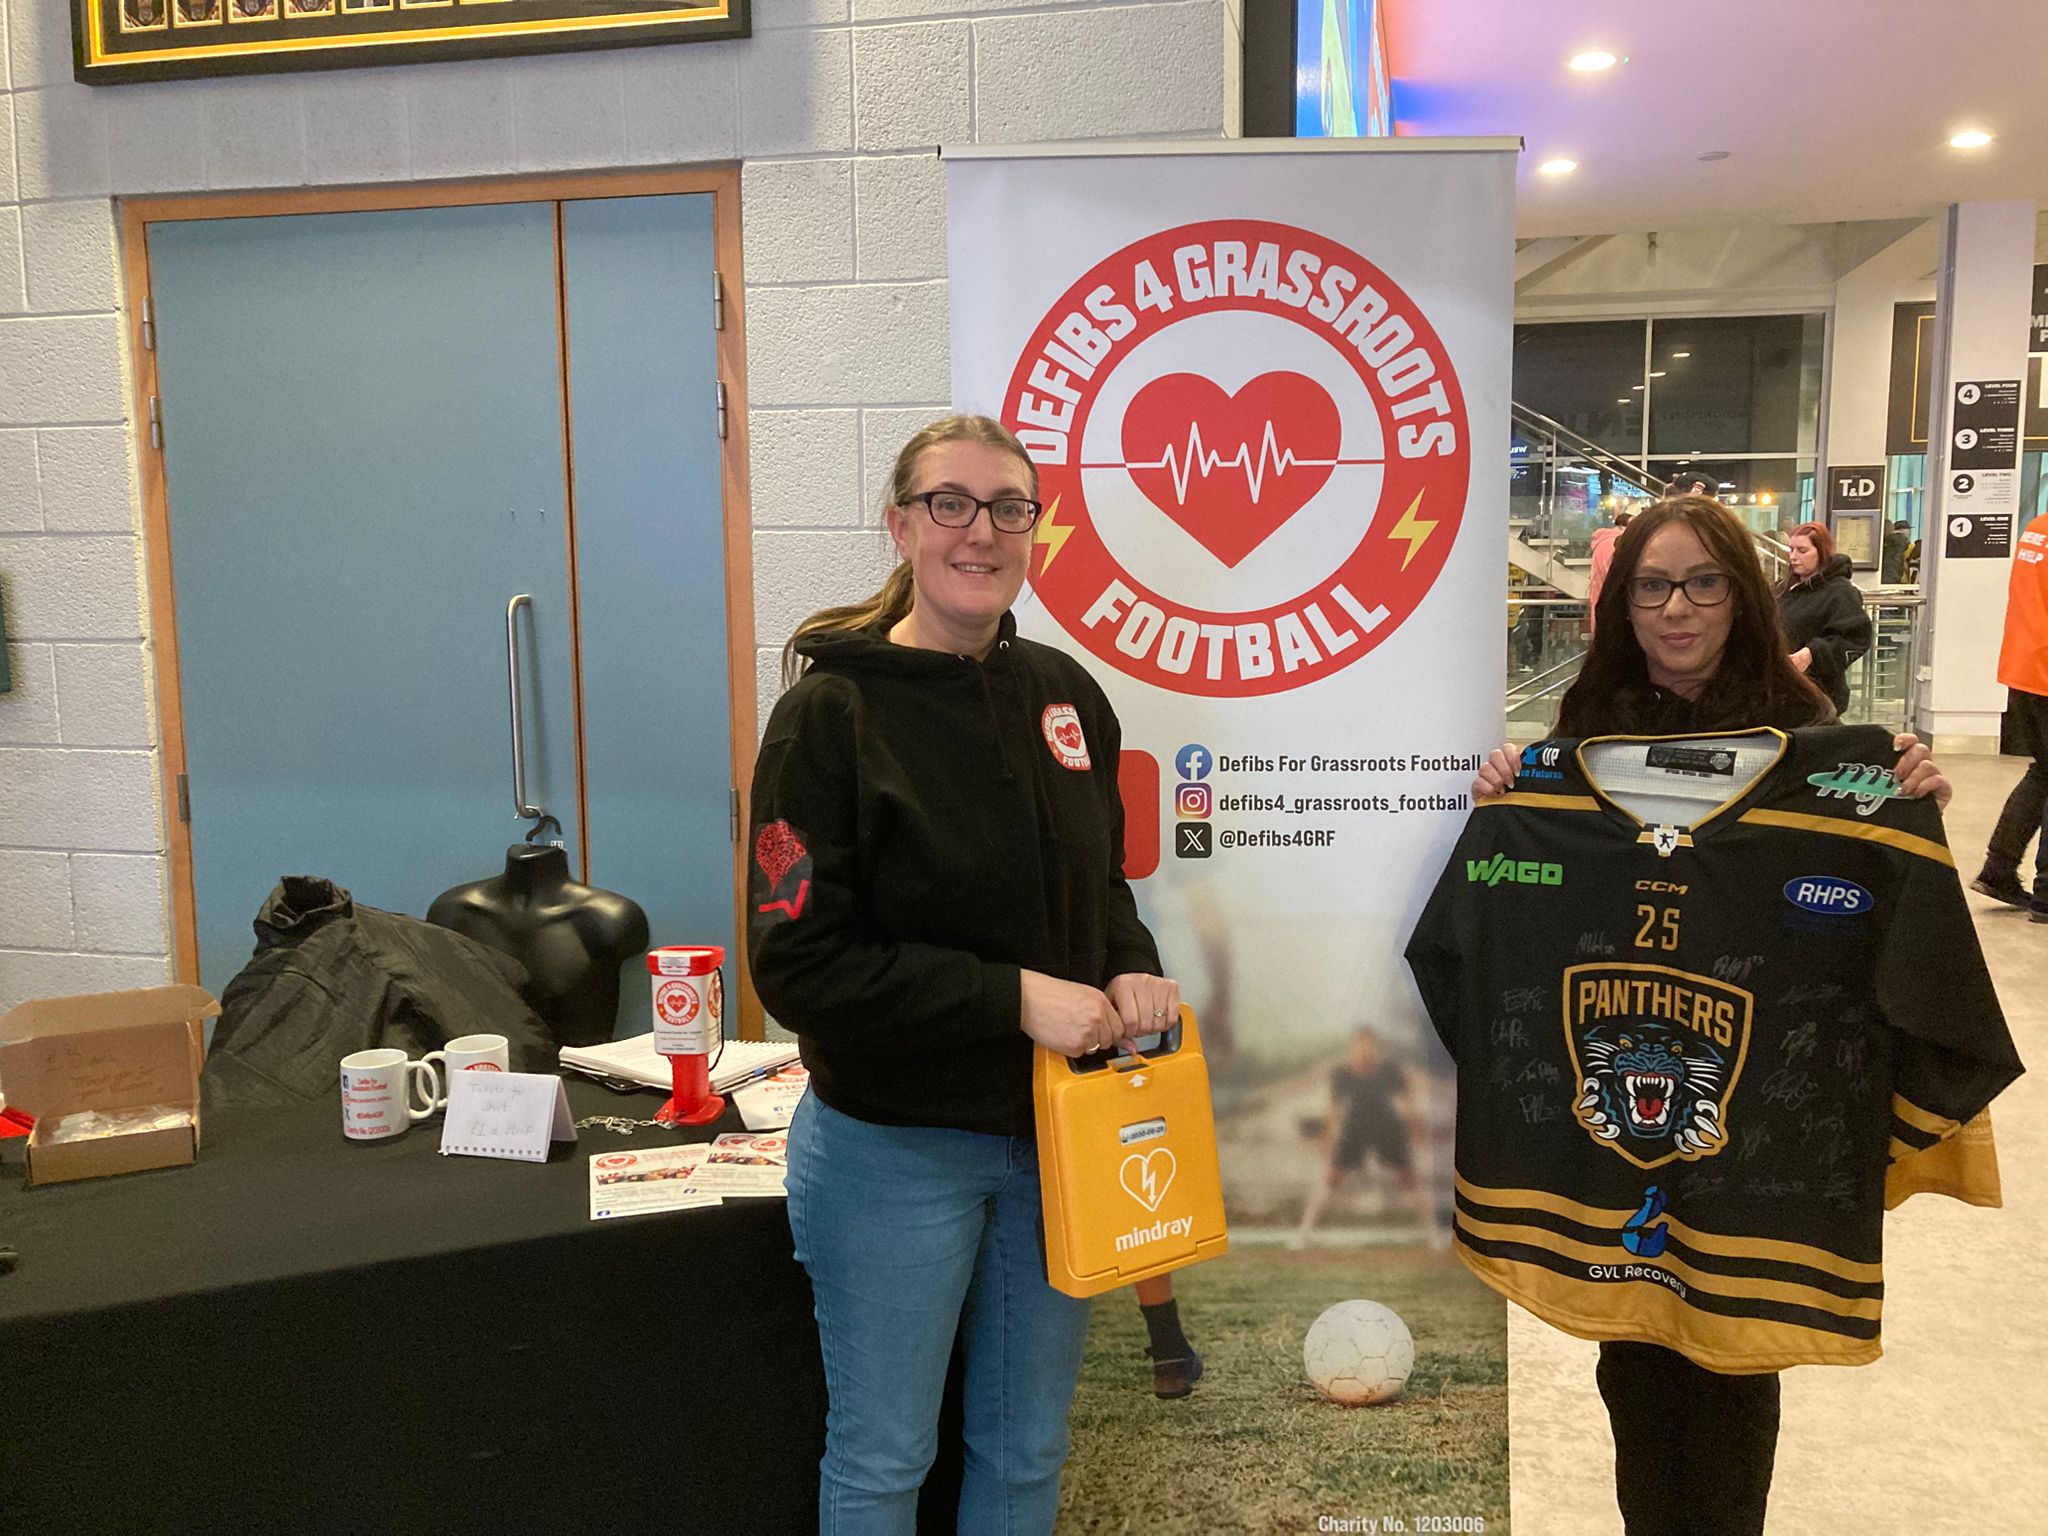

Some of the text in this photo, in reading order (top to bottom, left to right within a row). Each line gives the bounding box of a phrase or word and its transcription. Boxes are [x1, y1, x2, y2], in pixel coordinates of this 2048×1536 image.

[1017, 240, 1456, 465] DEFIBS 4 GRASSROOTS
[1963, 389, 1973, 399] 4
[1961, 434, 1971, 444] 3
[1839, 479, 1875, 497] T&D
[1958, 478, 1969, 489] 2
[2018, 548, 2044, 564] HELP
[1080, 578, 1391, 681] FOOTBALL
[1219, 754, 1481, 772] Defibs For Grassroots Football
[1542, 747, 1560, 767] UP
[1531, 768, 1563, 780] Futures
[1219, 795, 1468, 814] defibs4_grassroots_football
[1219, 830, 1336, 848] @Defibs4GRF
[1466, 852, 1563, 887] WAGO
[1635, 880, 1689, 895] CCM
[1797, 883, 1861, 908] RHPS
[1634, 904, 1680, 951] 25
[1579, 979, 1735, 1047] PANTHERS
[1115, 1216, 1193, 1252] mindray
[1588, 1265, 1687, 1298] GVL Recovery
[1318, 1515, 1485, 1535] Charity No. 1203006
